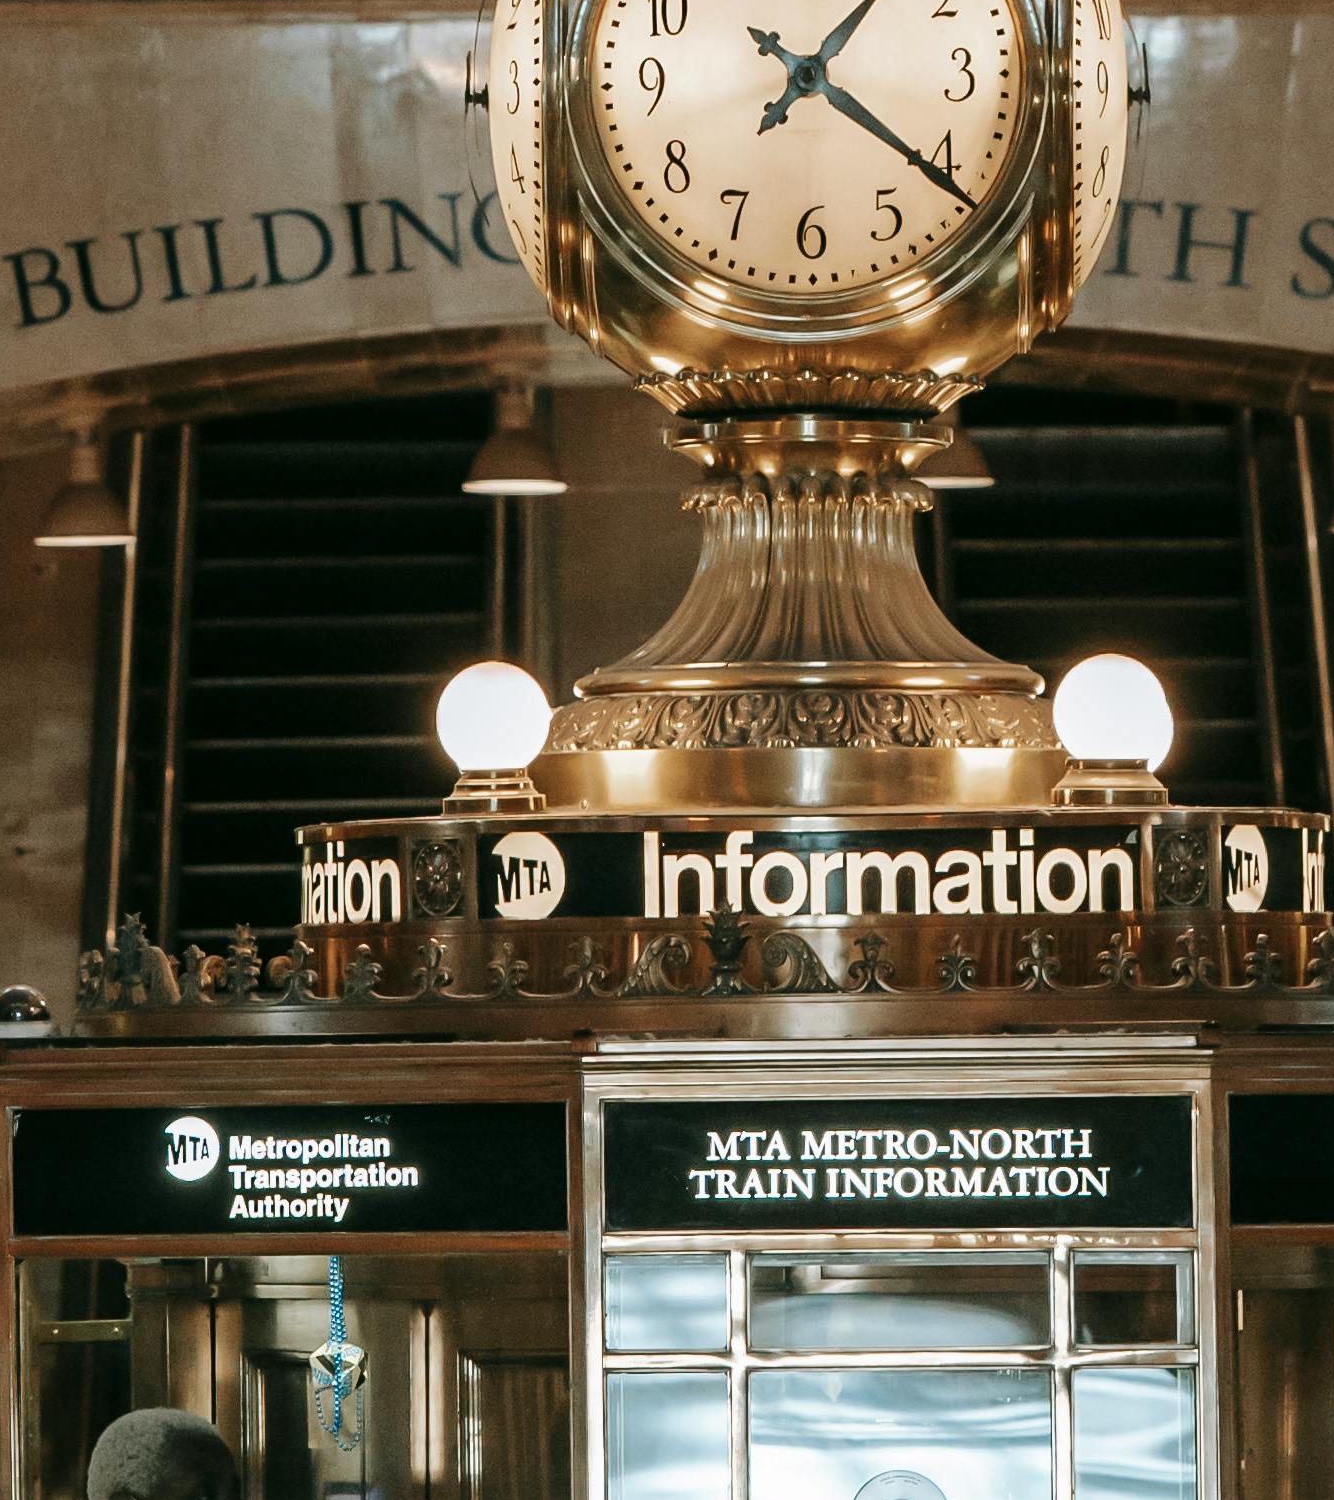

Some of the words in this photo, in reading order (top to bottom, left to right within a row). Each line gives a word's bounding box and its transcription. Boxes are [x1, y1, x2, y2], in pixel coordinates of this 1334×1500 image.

[506, 60, 521, 116] 3
[638, 57, 665, 117] 9
[944, 47, 975, 102] 3
[1096, 59, 1110, 119] 9
[509, 141, 526, 195] 4
[663, 139, 691, 194] 8
[931, 129, 962, 181] 4
[1091, 144, 1110, 199] 8
[720, 189, 750, 241] 7
[796, 205, 827, 260] 6
[870, 187, 903, 242] 5
[643, 828, 1134, 918] Information
[228, 1134, 391, 1162] Metropolitan
[705, 1130, 789, 1162] MTA
[800, 1127, 1092, 1160] METRO-NORTH
[227, 1164, 419, 1191] Transportation
[689, 1169, 816, 1199] TRAIN
[825, 1166, 1111, 1199] INFORMATION
[229, 1194, 350, 1223] Authority
